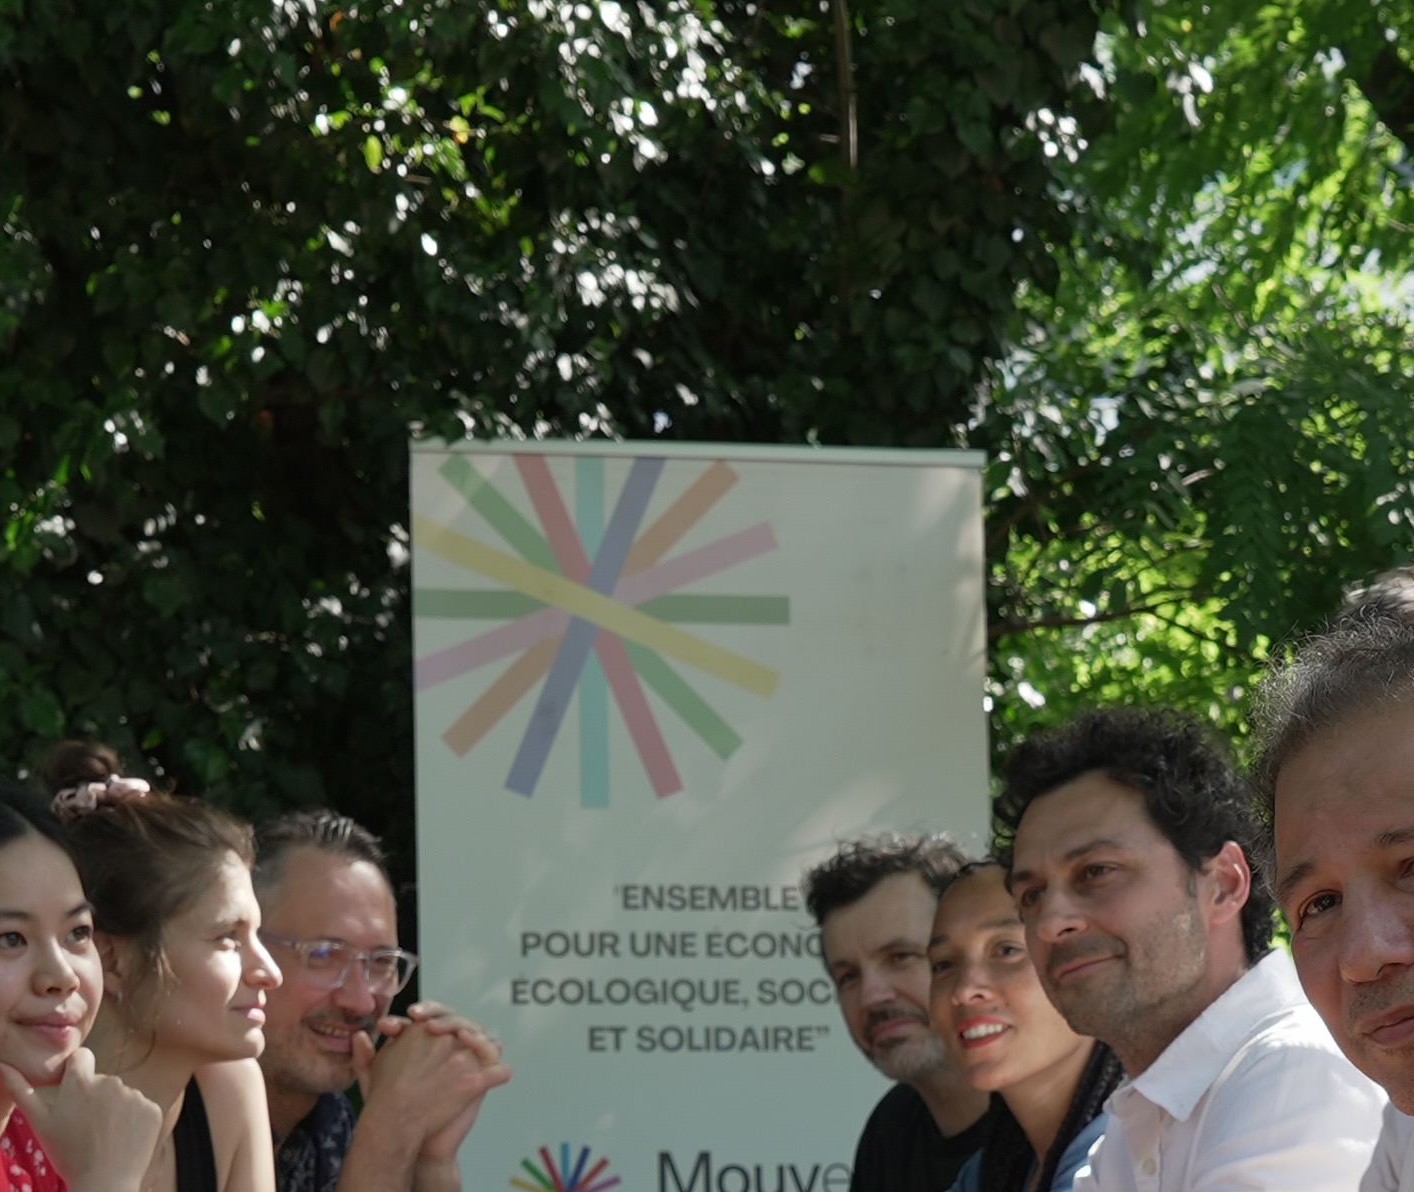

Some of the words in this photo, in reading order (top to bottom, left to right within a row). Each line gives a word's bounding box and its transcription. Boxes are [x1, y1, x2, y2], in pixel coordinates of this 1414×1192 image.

[521, 930, 621, 959] POUR
[630, 931, 698, 959] UNE
[511, 971, 749, 1012] ÉCOLOGIQUE,
[757, 978, 832, 1006] SOC
[588, 1025, 628, 1052] ET
